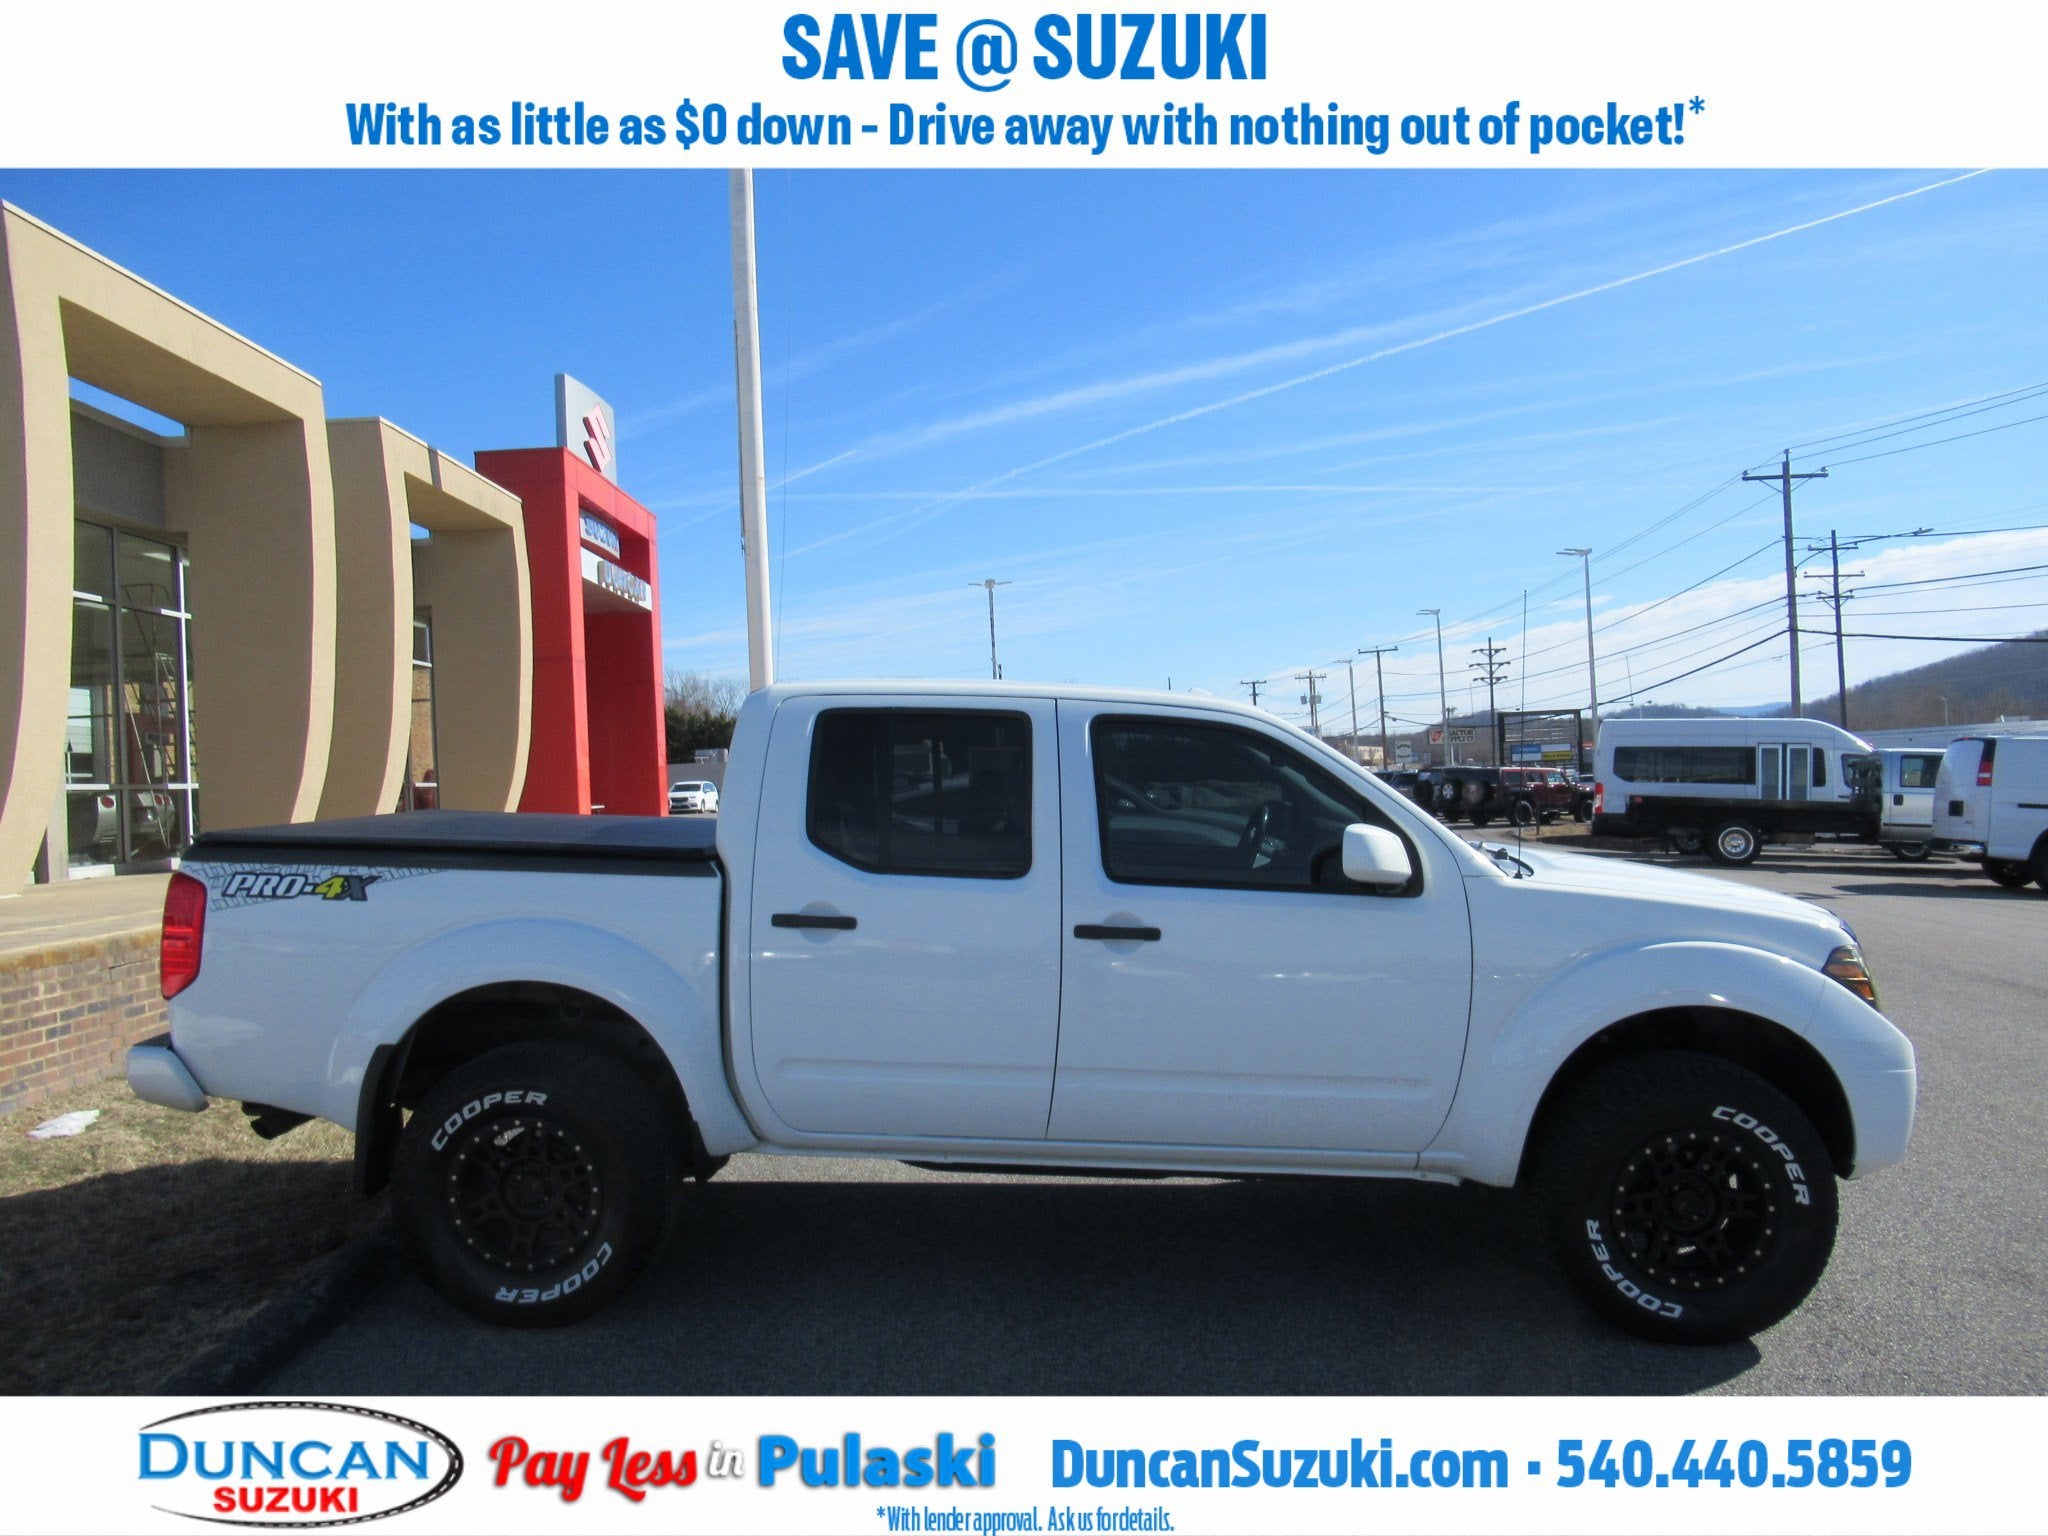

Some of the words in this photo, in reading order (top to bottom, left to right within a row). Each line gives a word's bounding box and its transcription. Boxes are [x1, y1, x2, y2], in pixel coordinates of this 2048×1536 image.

[221, 872, 383, 901] PRO-4X
[431, 1090, 548, 1151] COOPER
[1712, 1105, 1811, 1205] COOPER
[494, 1242, 613, 1303] COOPER
[1586, 1219, 1683, 1318] COOPER
